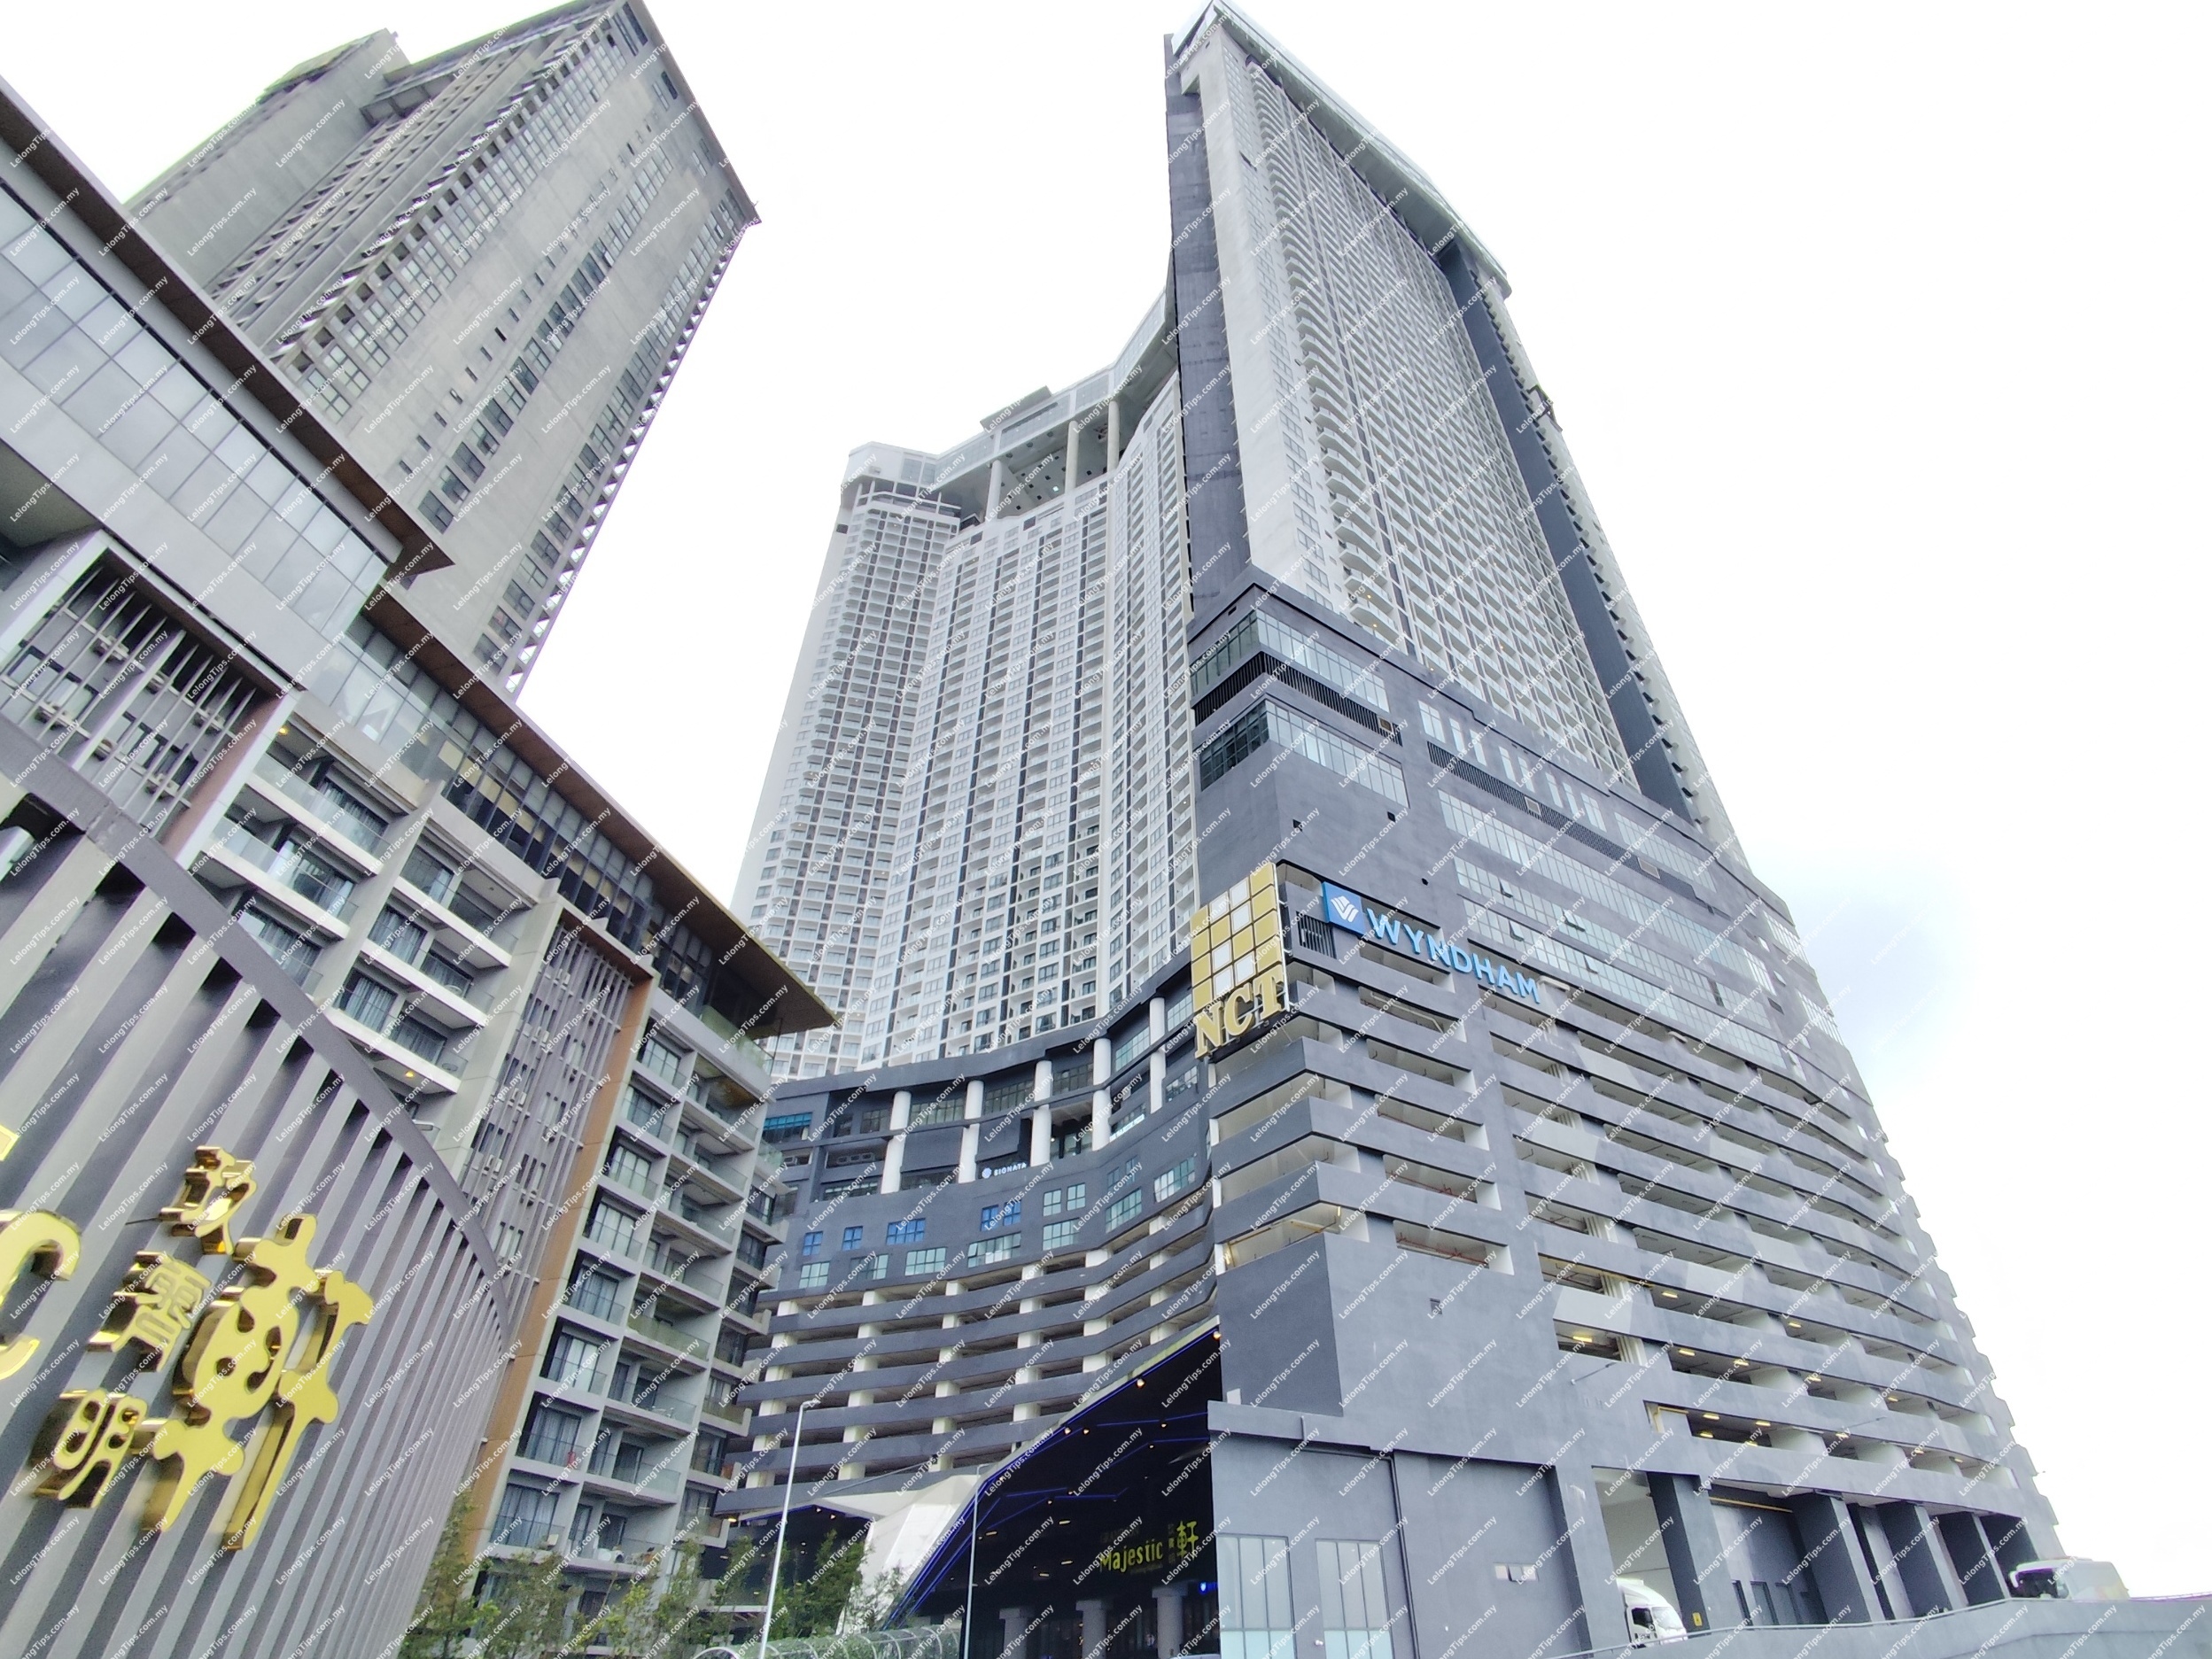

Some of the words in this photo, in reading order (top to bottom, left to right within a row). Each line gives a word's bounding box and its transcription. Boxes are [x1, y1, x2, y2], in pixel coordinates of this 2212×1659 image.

[1366, 907, 1541, 1004] WYNDHAM
[1195, 961, 1284, 1061] NCT
[1099, 1539, 1163, 1573] Majestic
